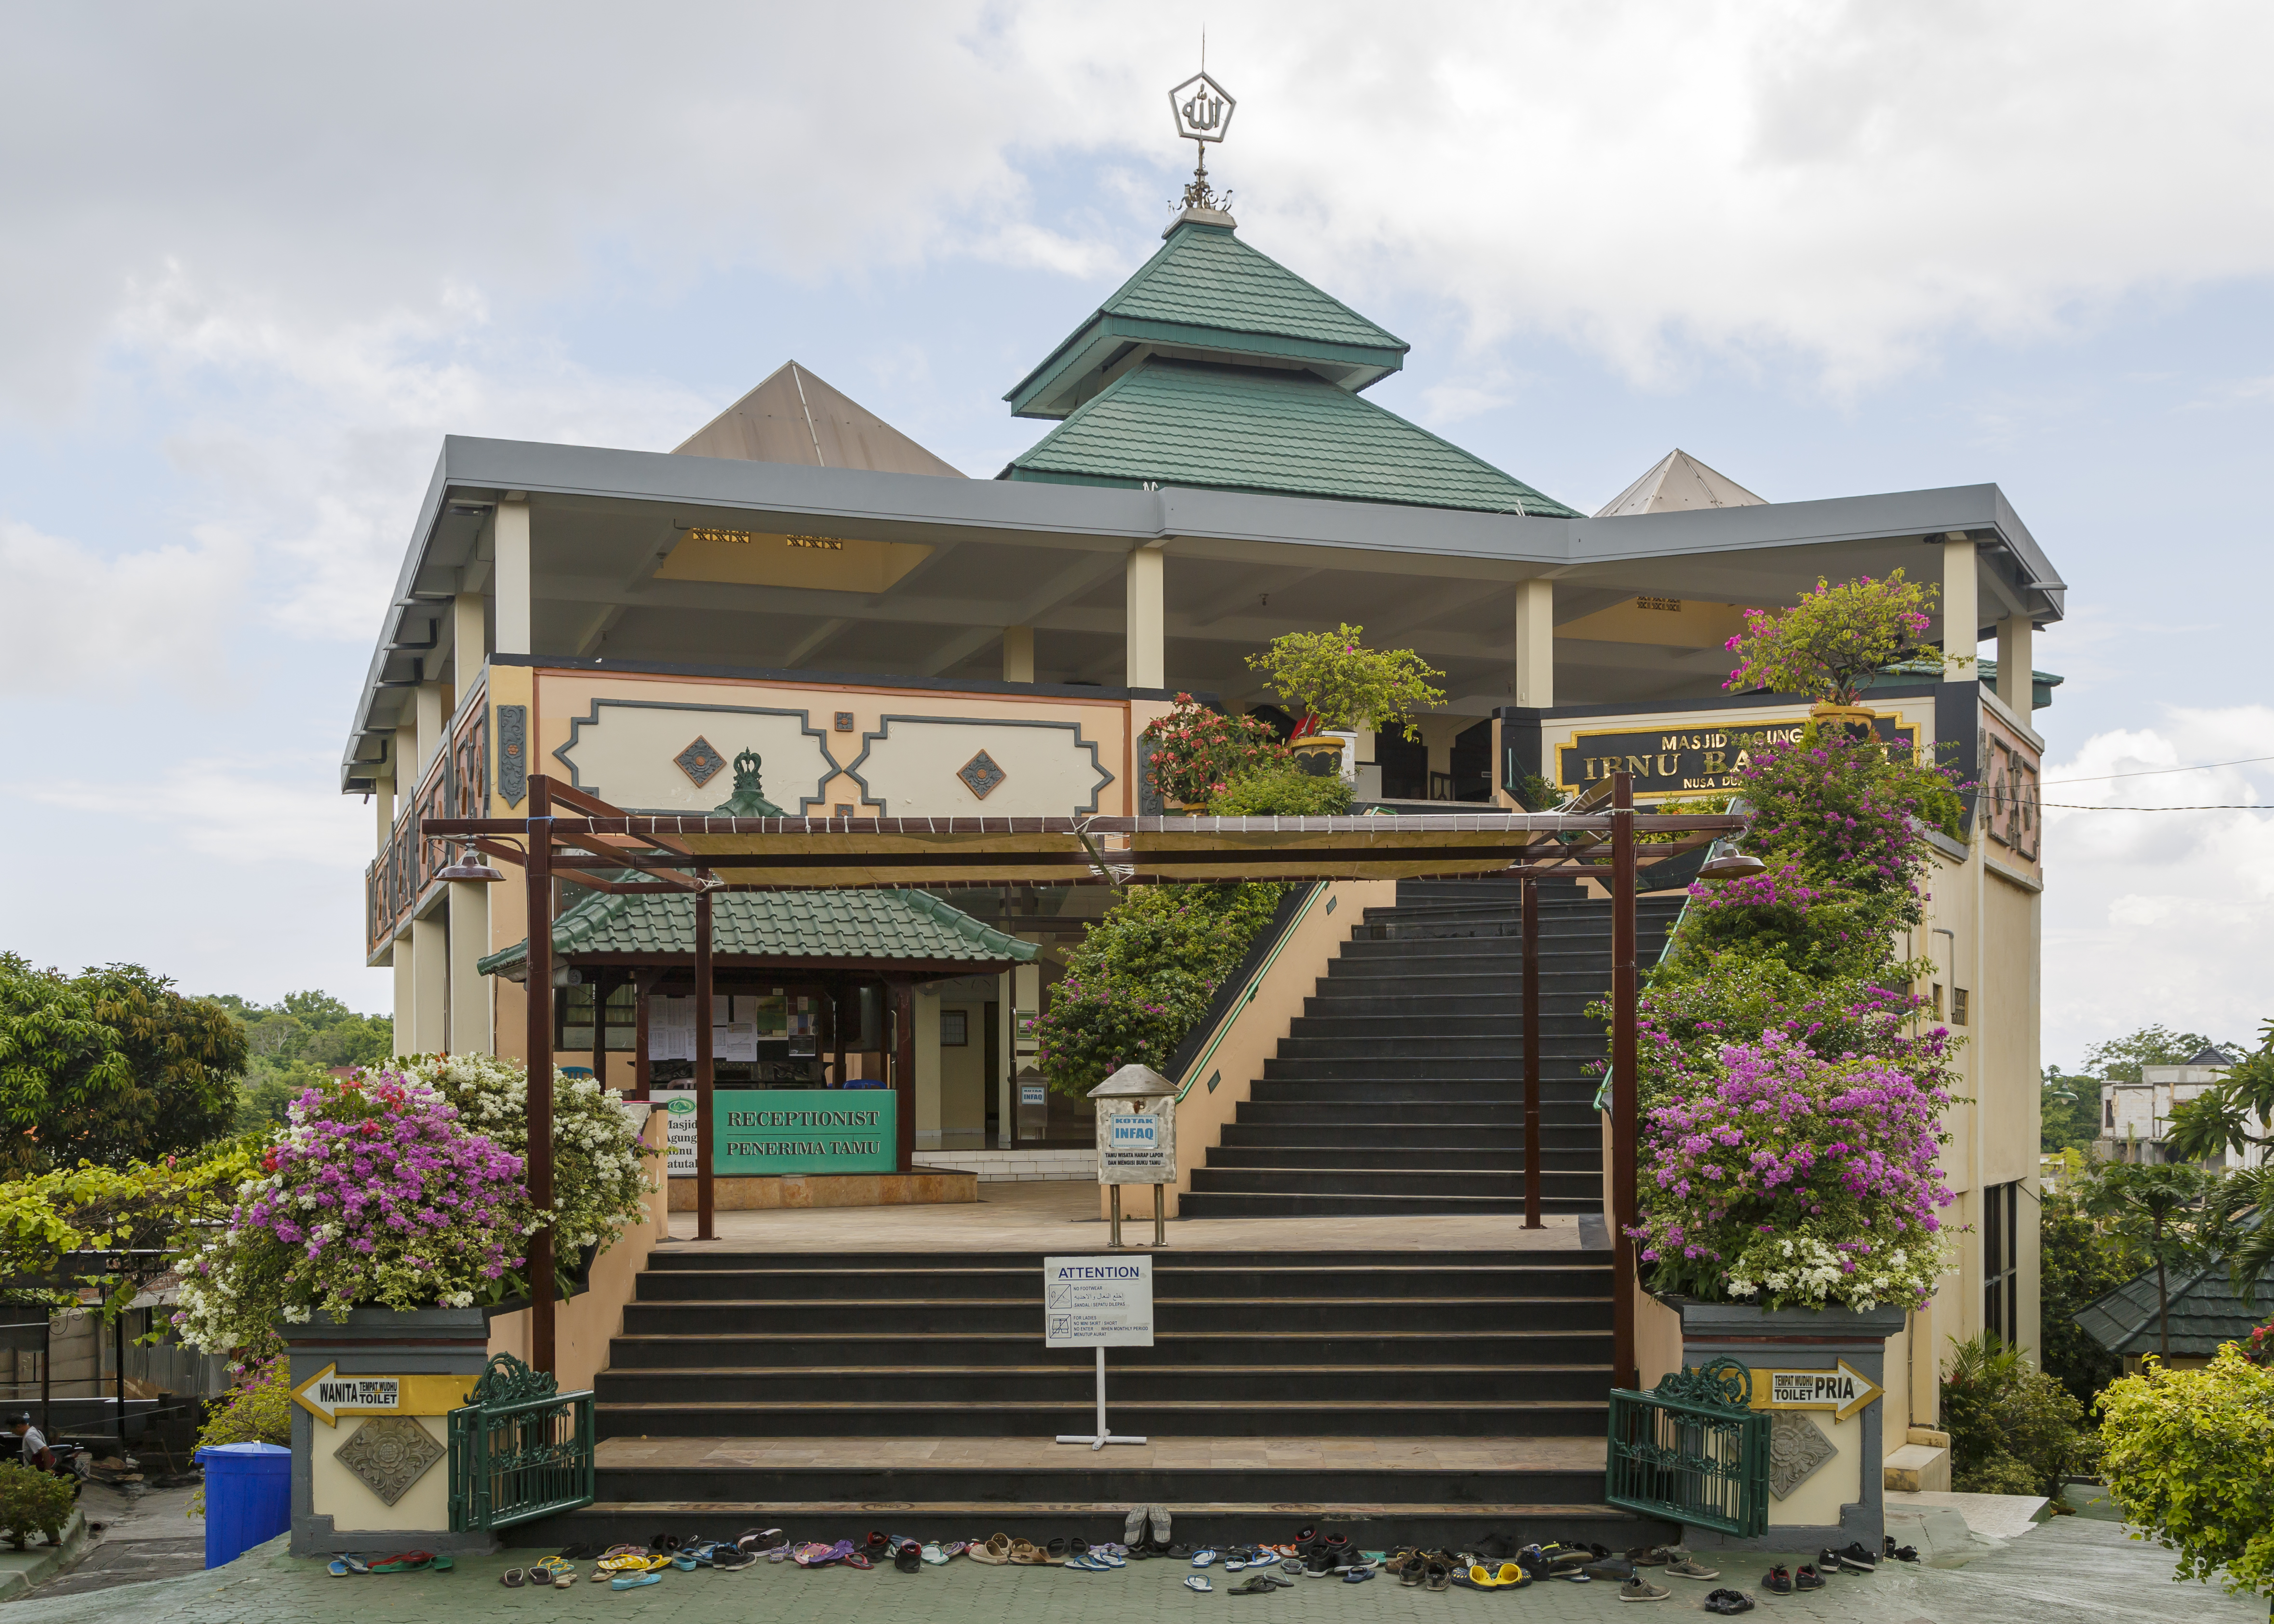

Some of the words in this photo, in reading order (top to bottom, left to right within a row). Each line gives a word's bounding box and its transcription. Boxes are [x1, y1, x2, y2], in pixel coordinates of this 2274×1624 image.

[1662, 733, 1727, 750] MASJID
[1583, 753, 1681, 780] IBNU
[1684, 777, 1715, 789] NUSA
[1722, 776, 1742, 786] DU
[727, 1110, 880, 1127] RECEPTIONIST
[1115, 1128, 1154, 1140] INFAQ
[726, 1141, 827, 1156] PENERIMA
[829, 1141, 881, 1155] TAMU
[668, 1159, 697, 1168] atuta
[1058, 1266, 1139, 1278] ATTENTION
[359, 1381, 378, 1391] TEMPAT
[379, 1382, 397, 1392] WUDHU
[1775, 1375, 1794, 1386] TEMPAT
[1795, 1375, 1813, 1386] WUDHU
[320, 1383, 358, 1402] WANITA
[1815, 1377, 1855, 1399] PRIA
[359, 1394, 397, 1404] TOILET
[1775, 1389, 1813, 1400] TOILET
